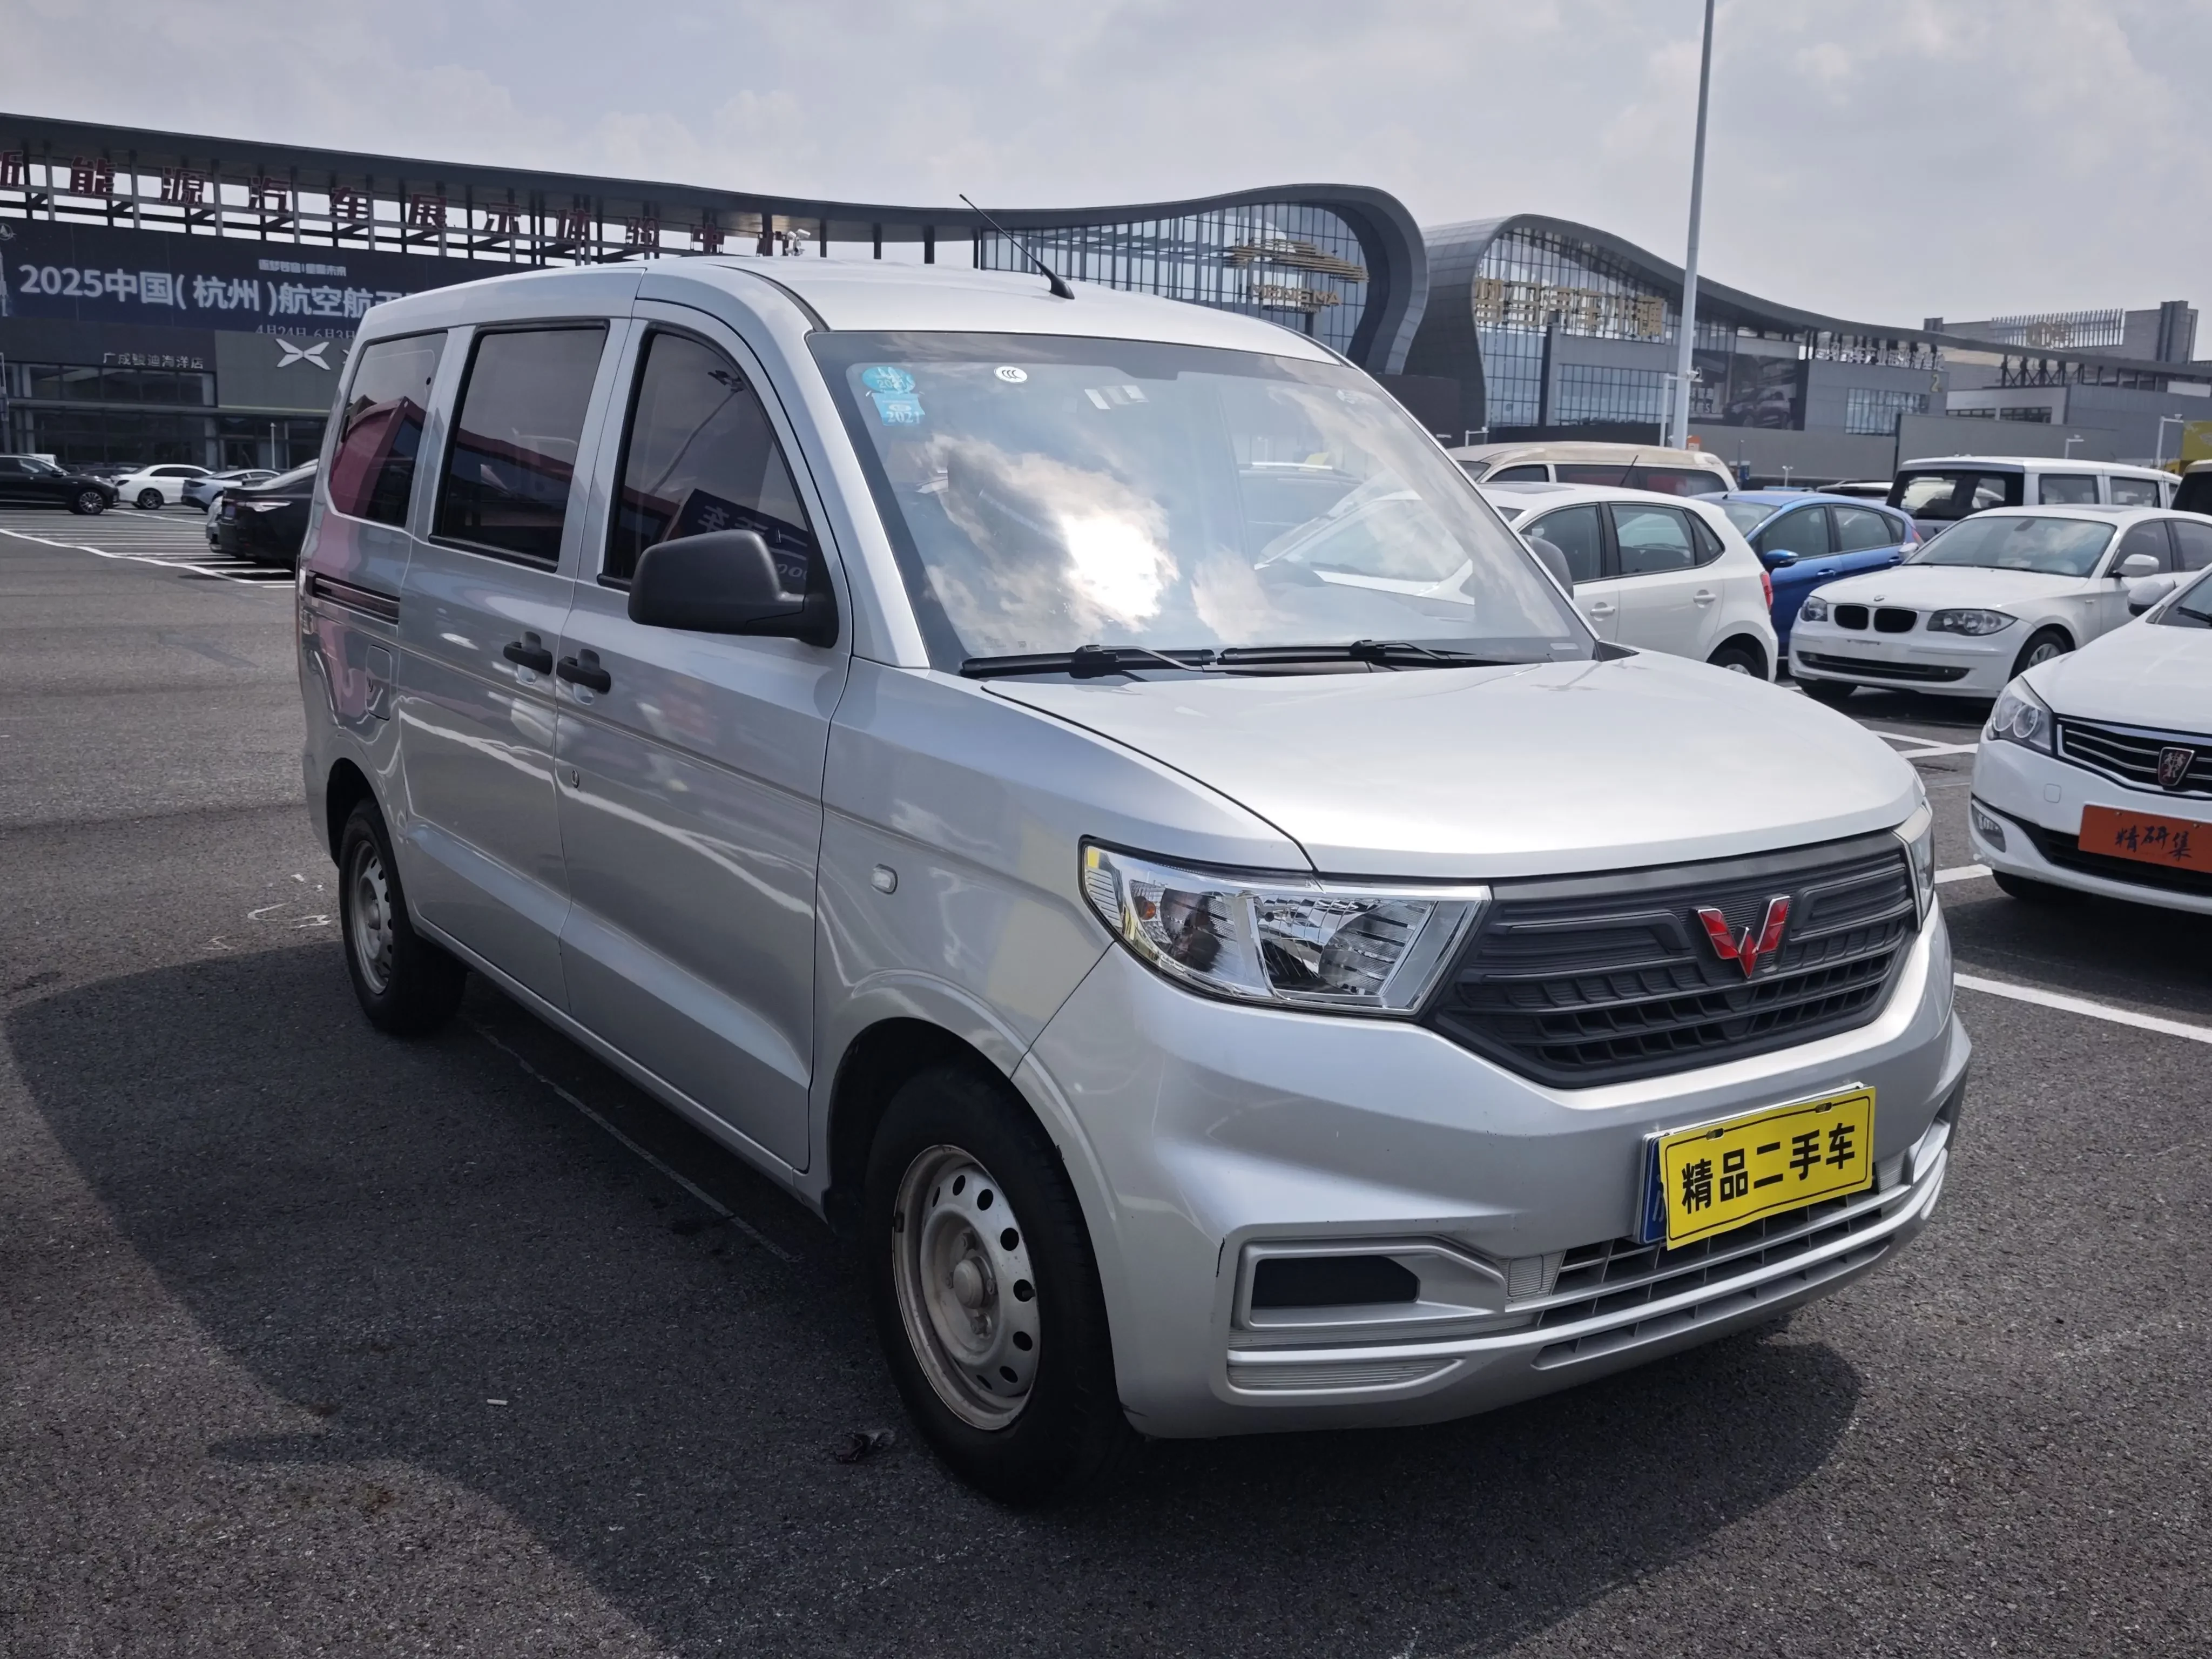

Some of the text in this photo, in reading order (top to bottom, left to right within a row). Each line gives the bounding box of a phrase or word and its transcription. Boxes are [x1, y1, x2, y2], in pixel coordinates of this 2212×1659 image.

[19, 265, 415, 318] 2025中国(杭州)航空航
[1930, 374, 1941, 393] 2
[886, 411, 920, 424] 2021
[2114, 825, 2193, 862] 精研集
[1682, 1123, 1855, 1214] 精品二手车
